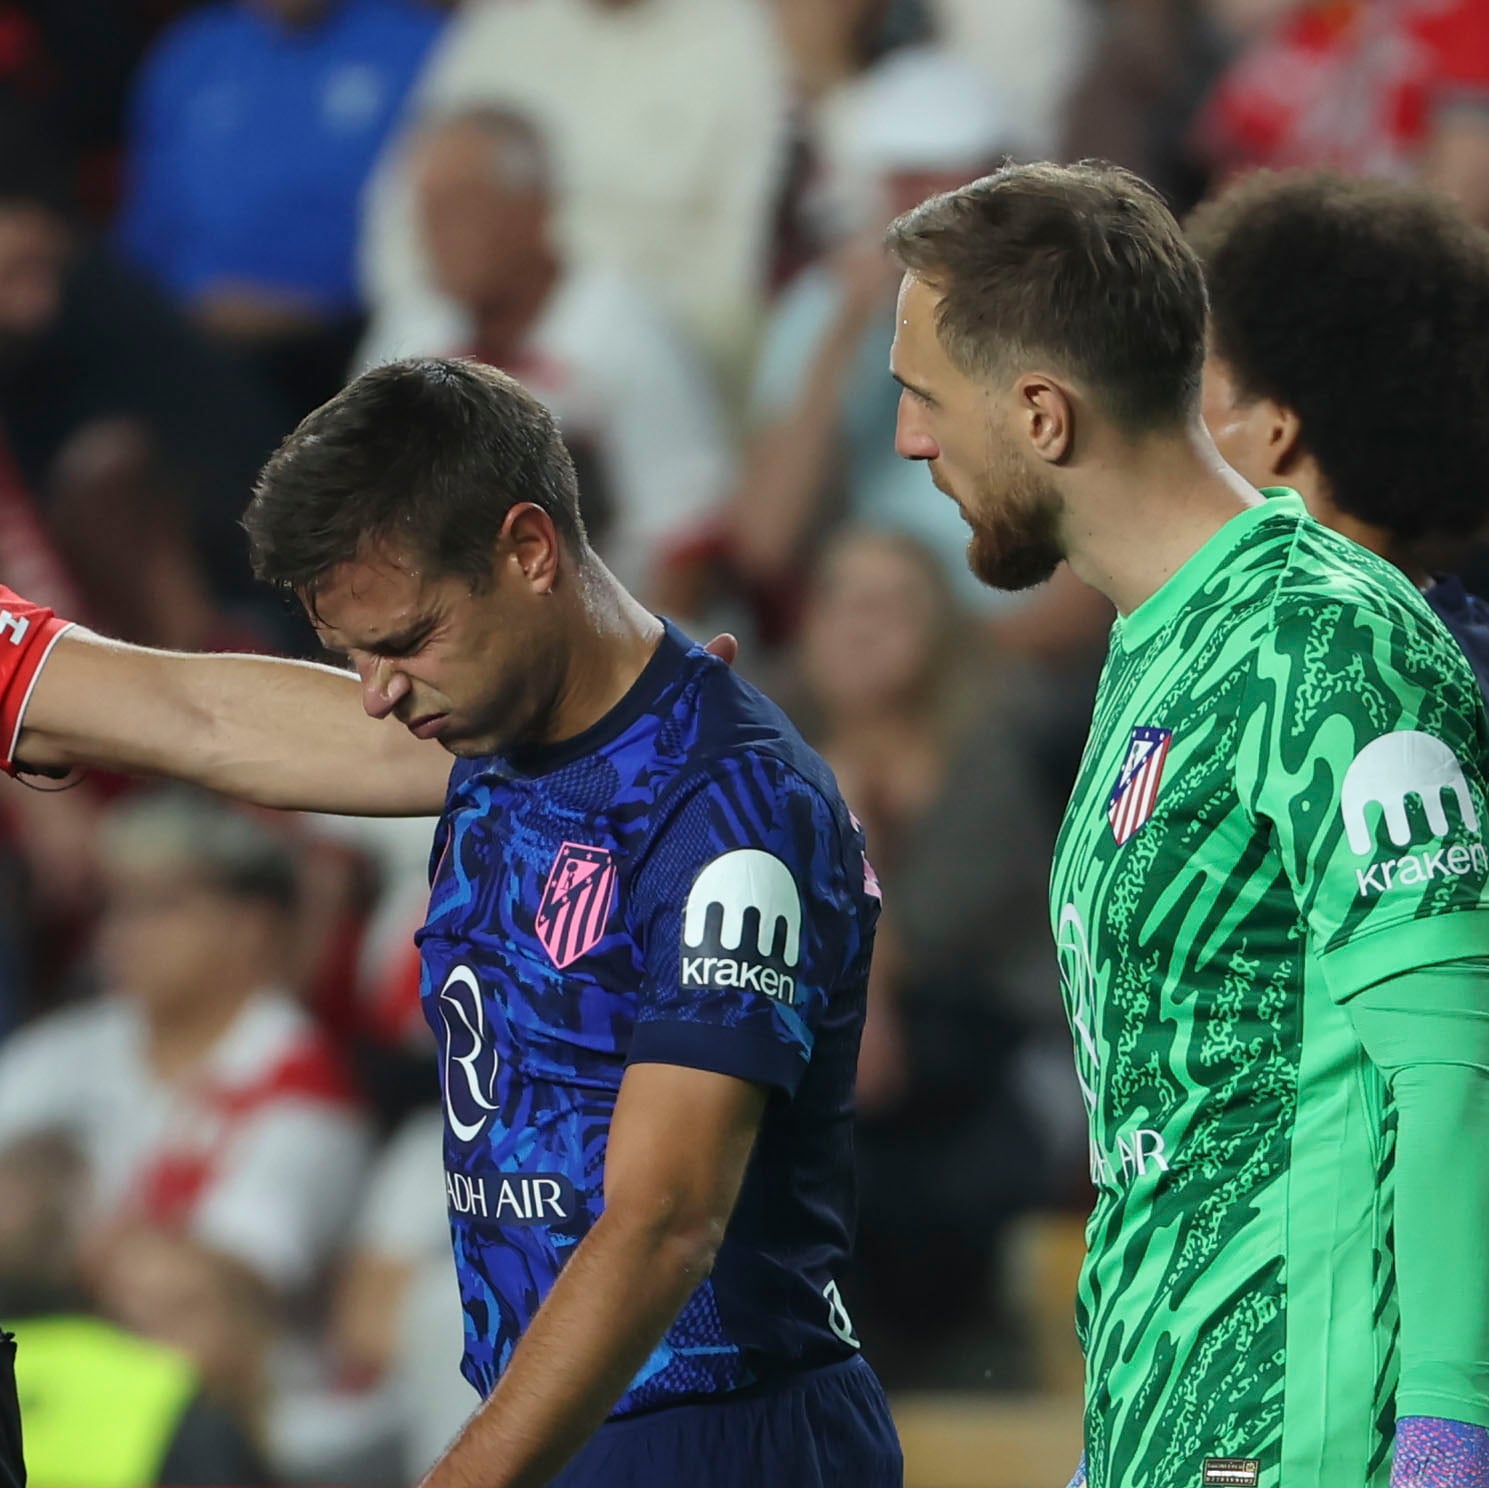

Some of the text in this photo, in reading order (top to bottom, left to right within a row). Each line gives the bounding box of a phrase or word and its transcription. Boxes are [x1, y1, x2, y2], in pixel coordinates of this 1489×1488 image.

[1355, 841, 1489, 897] kraken
[681, 956, 794, 1005] kraken
[496, 1179, 567, 1219] AIR
